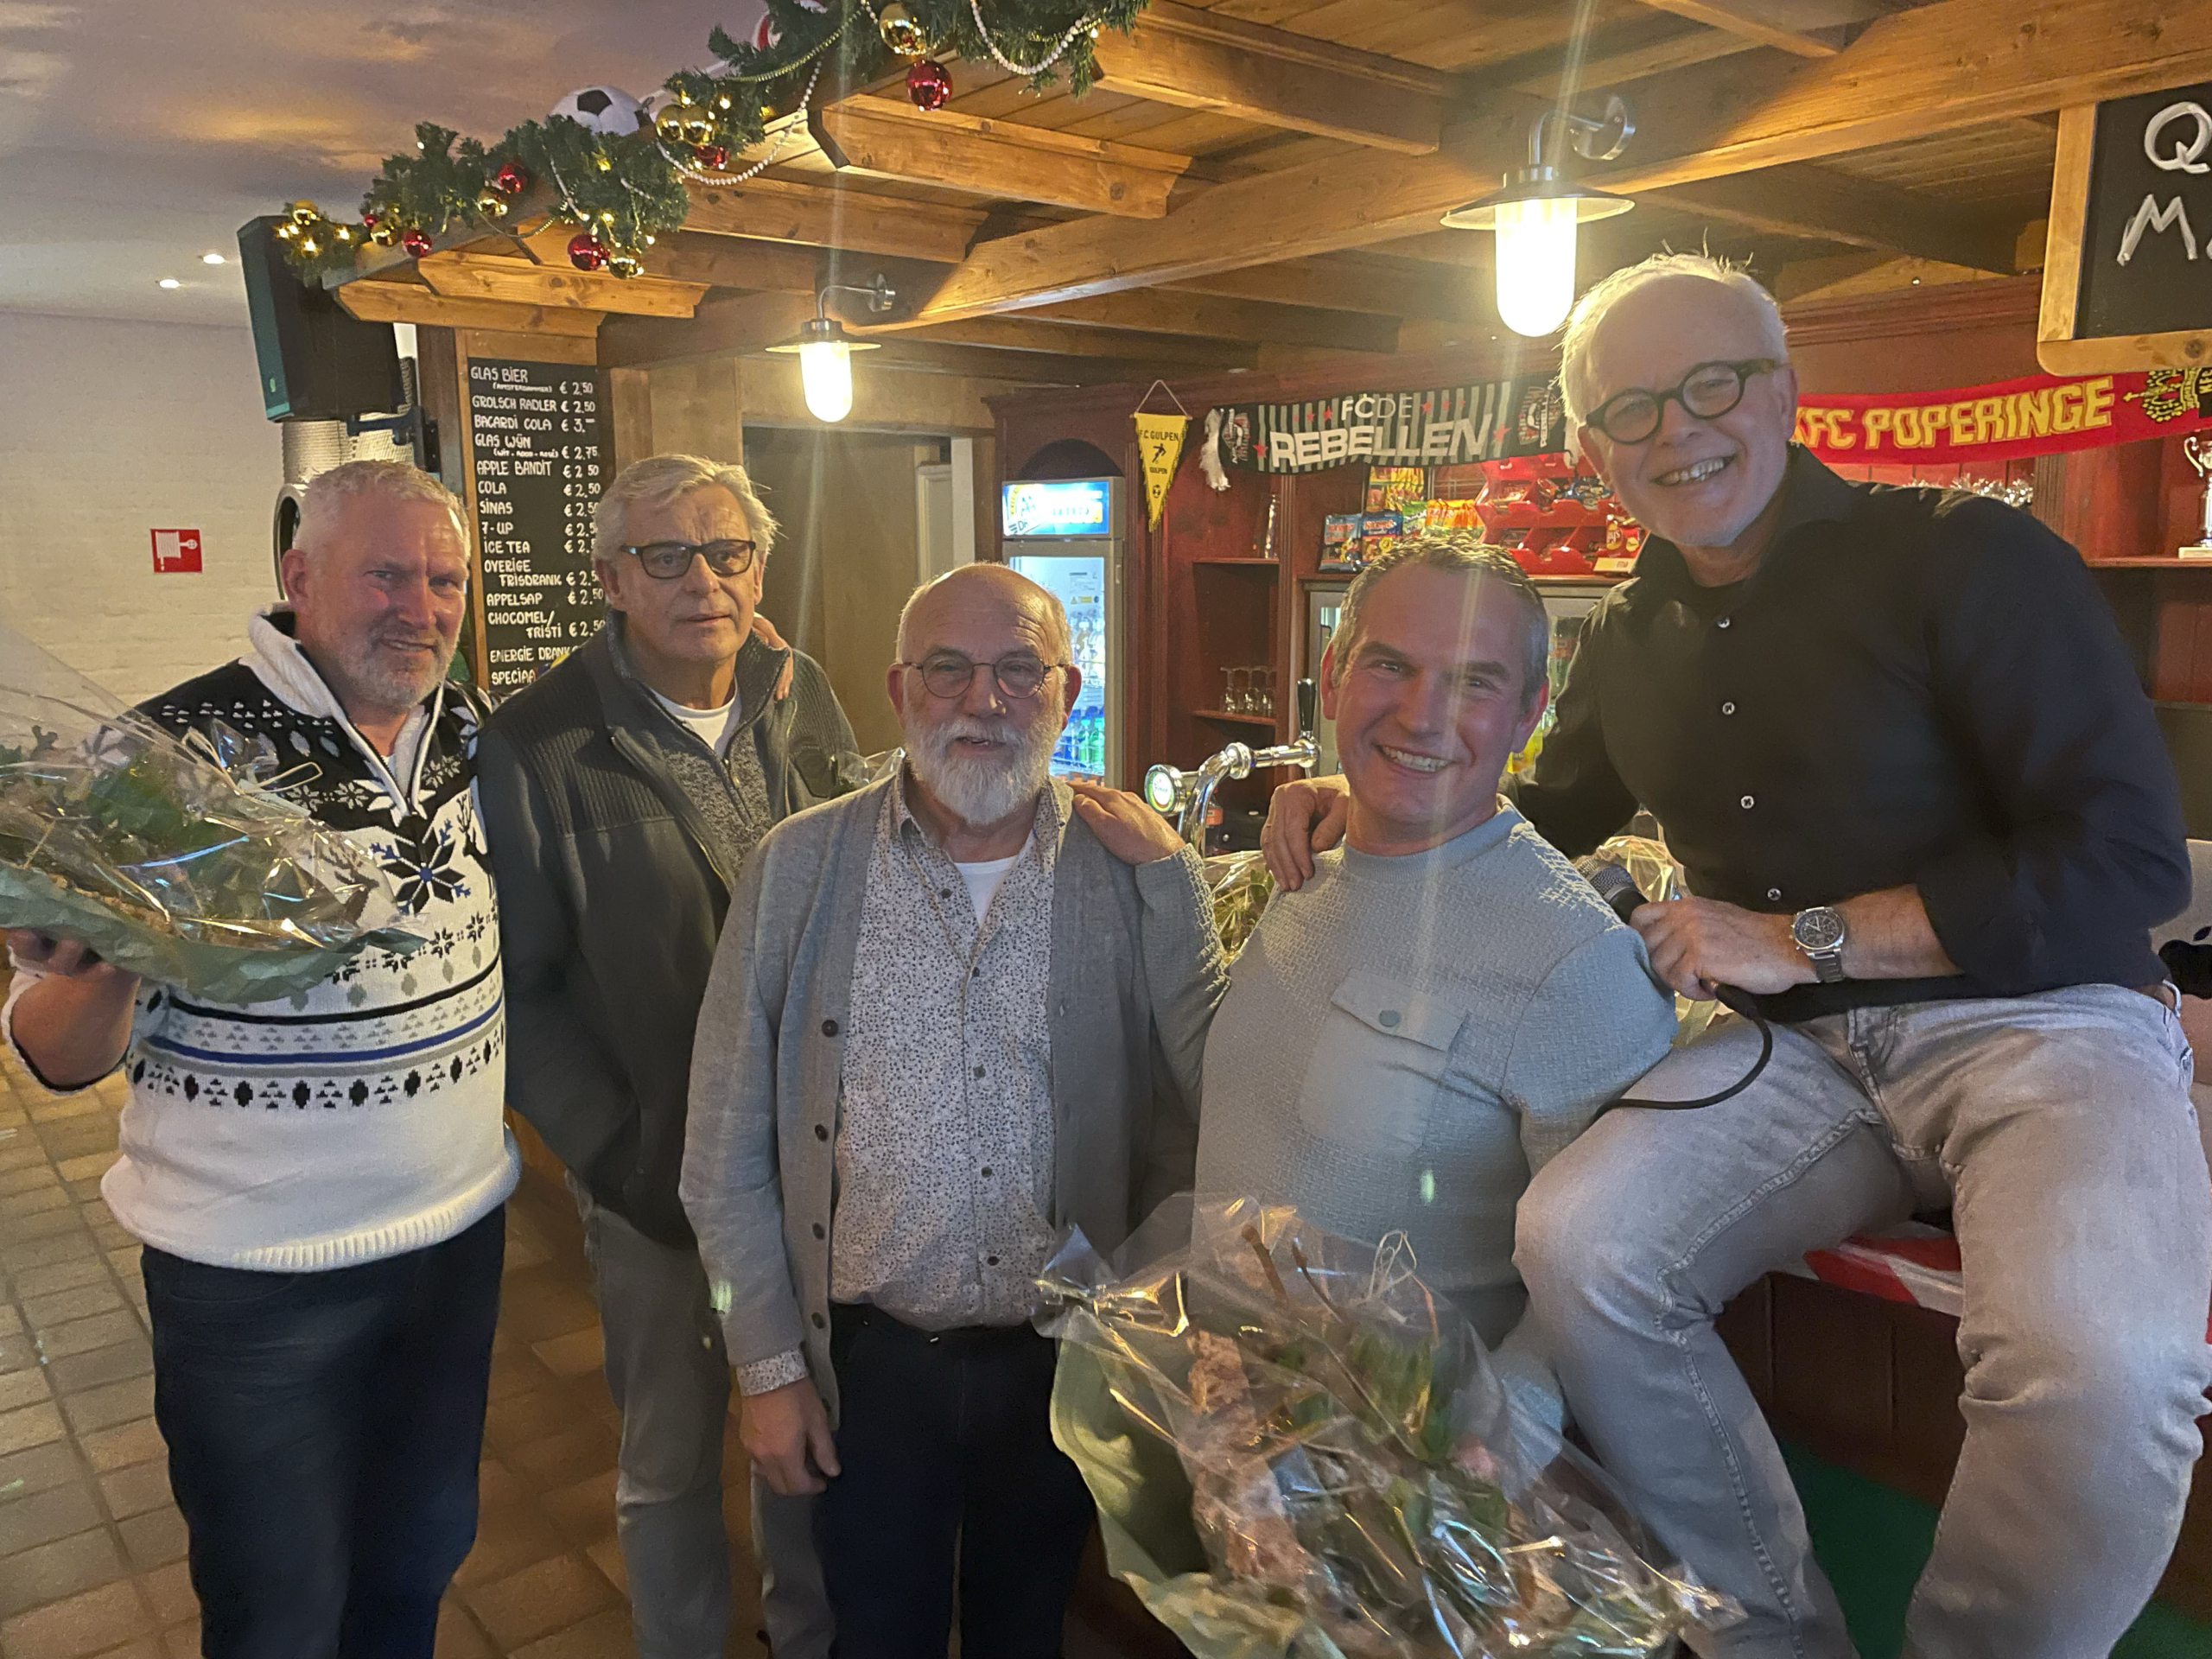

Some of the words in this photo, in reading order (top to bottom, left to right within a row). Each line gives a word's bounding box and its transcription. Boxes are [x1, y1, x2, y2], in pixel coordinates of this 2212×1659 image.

[2117, 194, 2212, 266] M
[471, 366, 499, 380] GLAS
[572, 382, 593, 395] 2.50
[472, 395, 517, 410] GROLSCH
[519, 398, 556, 412] RADLER
[573, 401, 595, 413] 2.50
[1341, 394, 1413, 421] FCDE
[1862, 376, 2114, 449] POPERINGE
[474, 415, 518, 429] BACARDI
[524, 417, 552, 430] COLA
[475, 433, 500, 448] GLAS
[1150, 430, 1179, 442] GULPEN
[1270, 413, 1492, 467] REBELLEN
[574, 446, 598, 460] 2.75
[477, 461, 509, 475] APPLE
[514, 460, 552, 476] BANDIT
[478, 480, 506, 494] COLA
[575, 483, 601, 499] 2.50
[480, 498, 513, 514] SINAS
[576, 522, 597, 537] 2.5
[483, 537, 504, 554] ICE
[505, 541, 531, 553] TEA
[579, 570, 599, 586] 2.5
[486, 593, 543, 607] APPELSAP
[580, 588, 603, 605] 2.50
[487, 610, 555, 627] CHOCOMEL/
[490, 645, 534, 663] ENERGIE
[491, 667, 536, 685] SPECIAA
